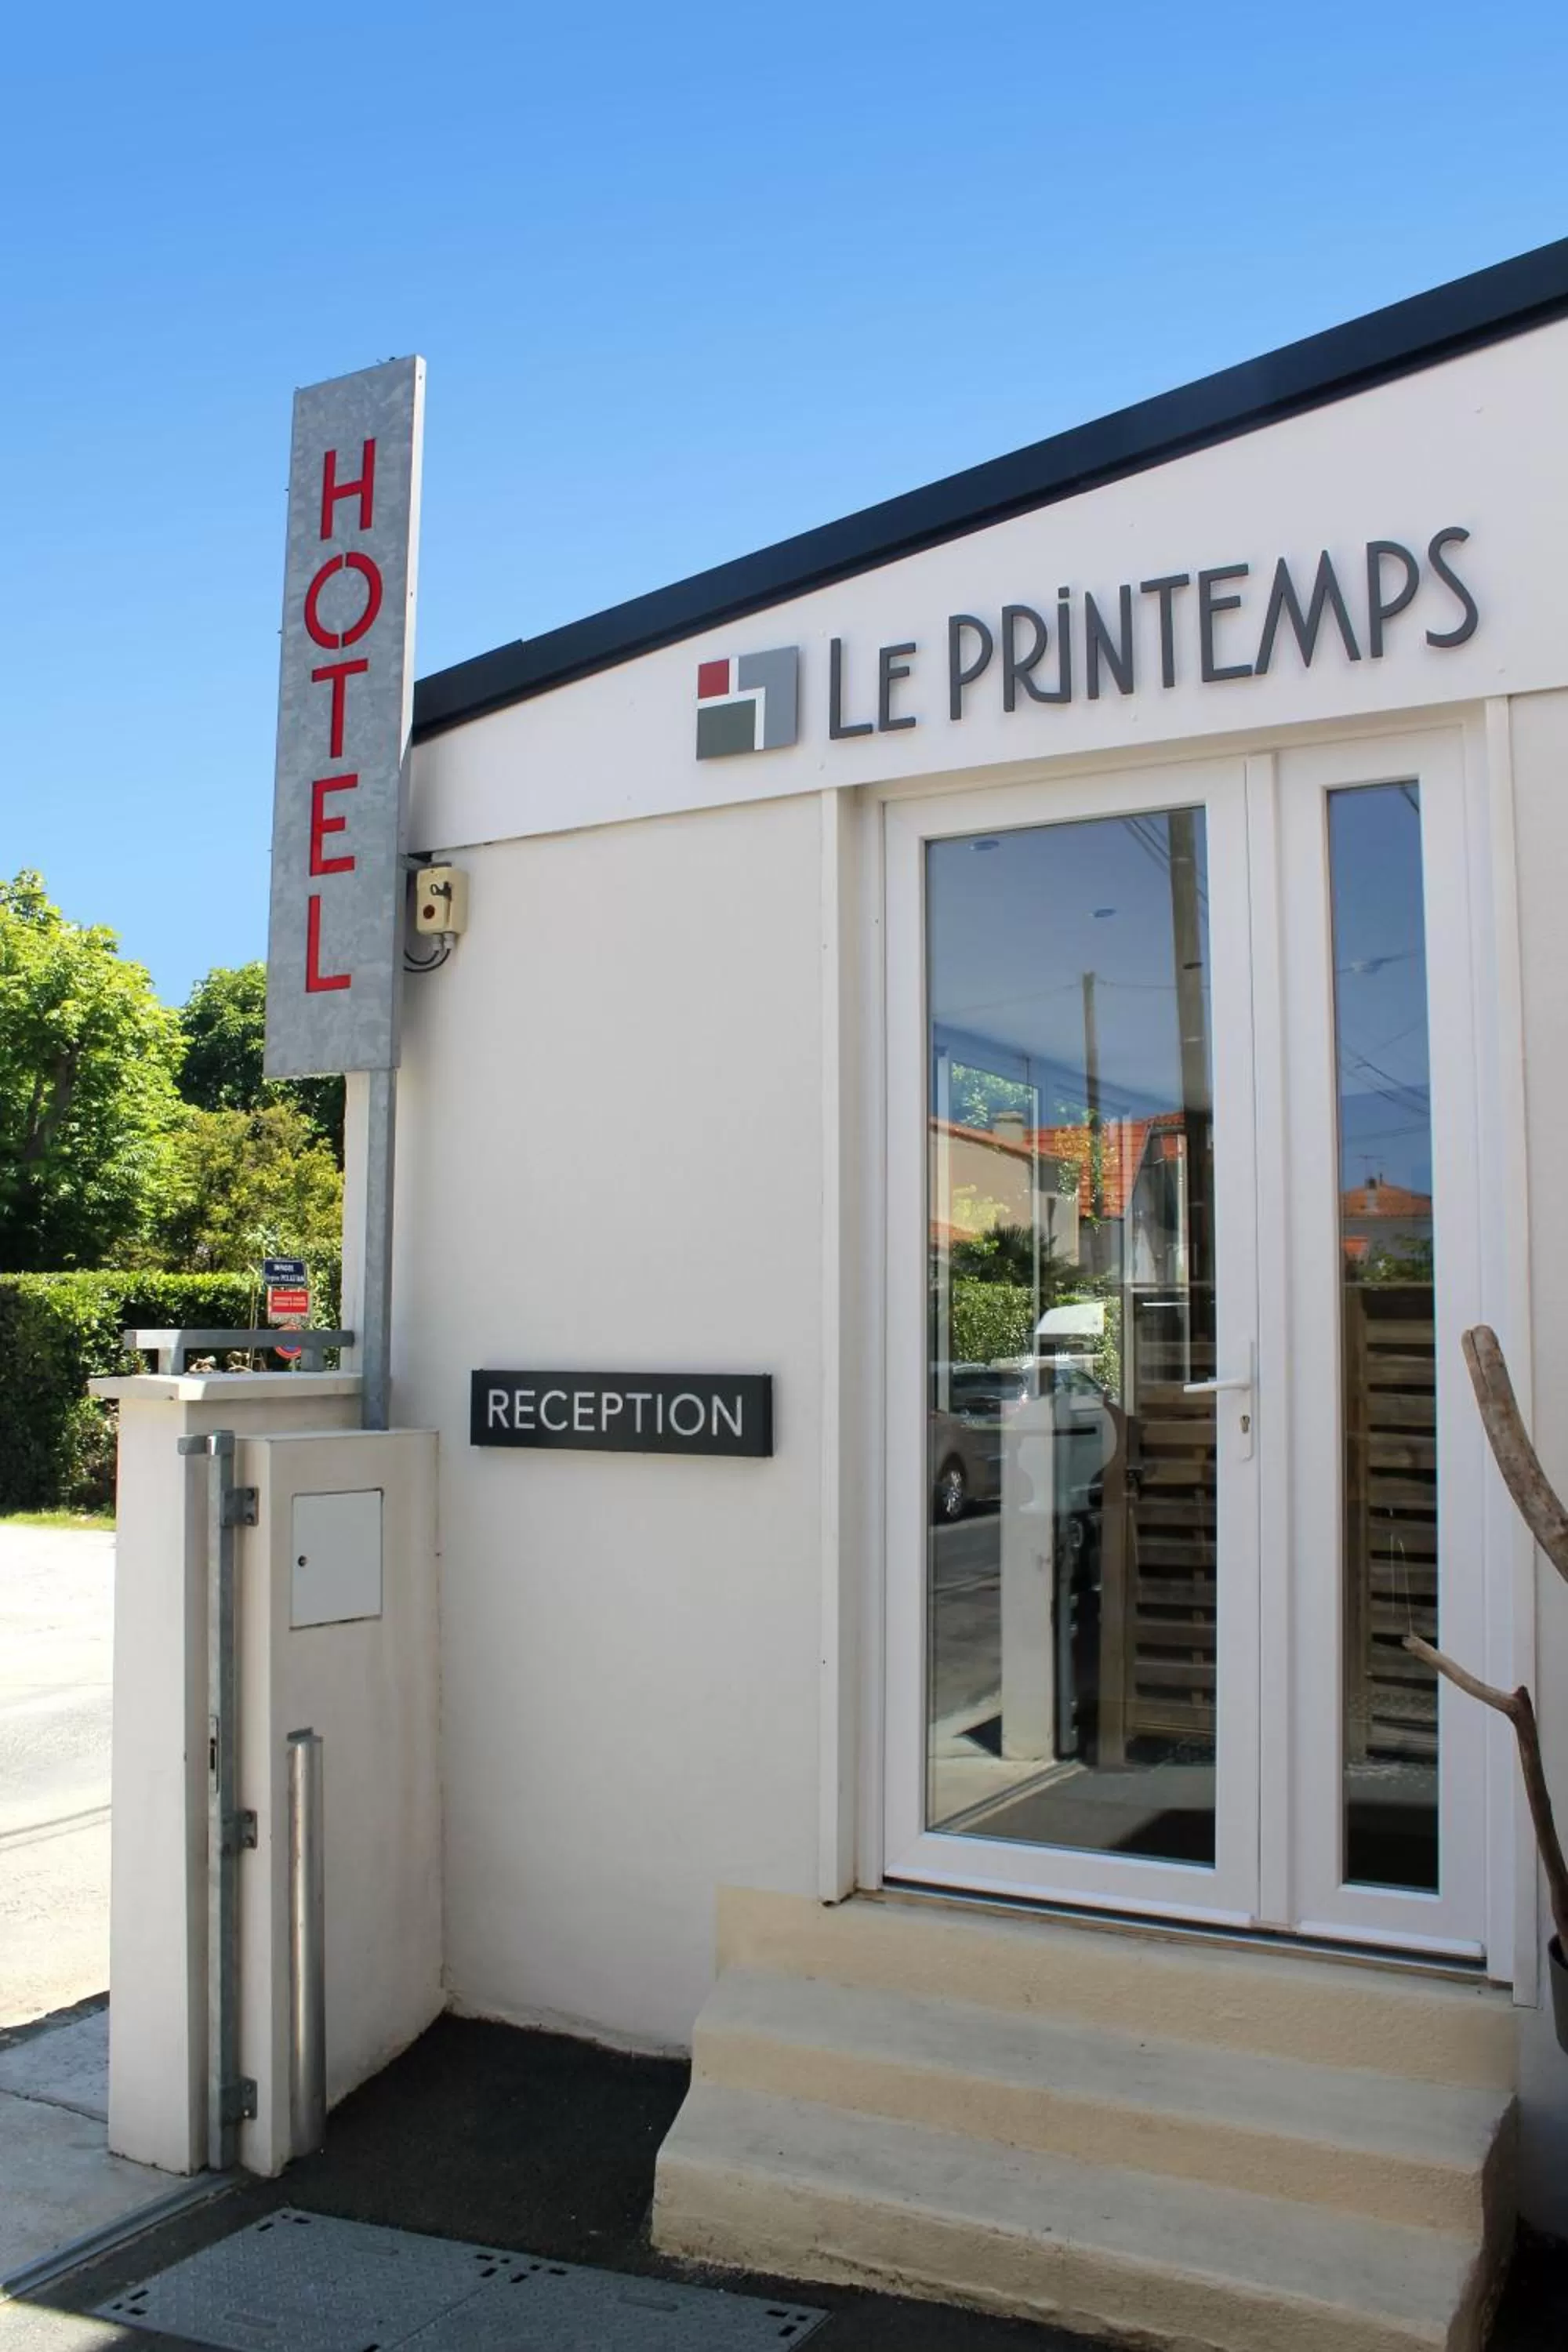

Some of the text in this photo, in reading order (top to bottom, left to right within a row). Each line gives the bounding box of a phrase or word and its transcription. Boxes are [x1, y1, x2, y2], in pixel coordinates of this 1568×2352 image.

[303, 437, 383, 993] HOTEL
[828, 637, 916, 740] LE
[488, 1388, 742, 1437] RECEPTION
